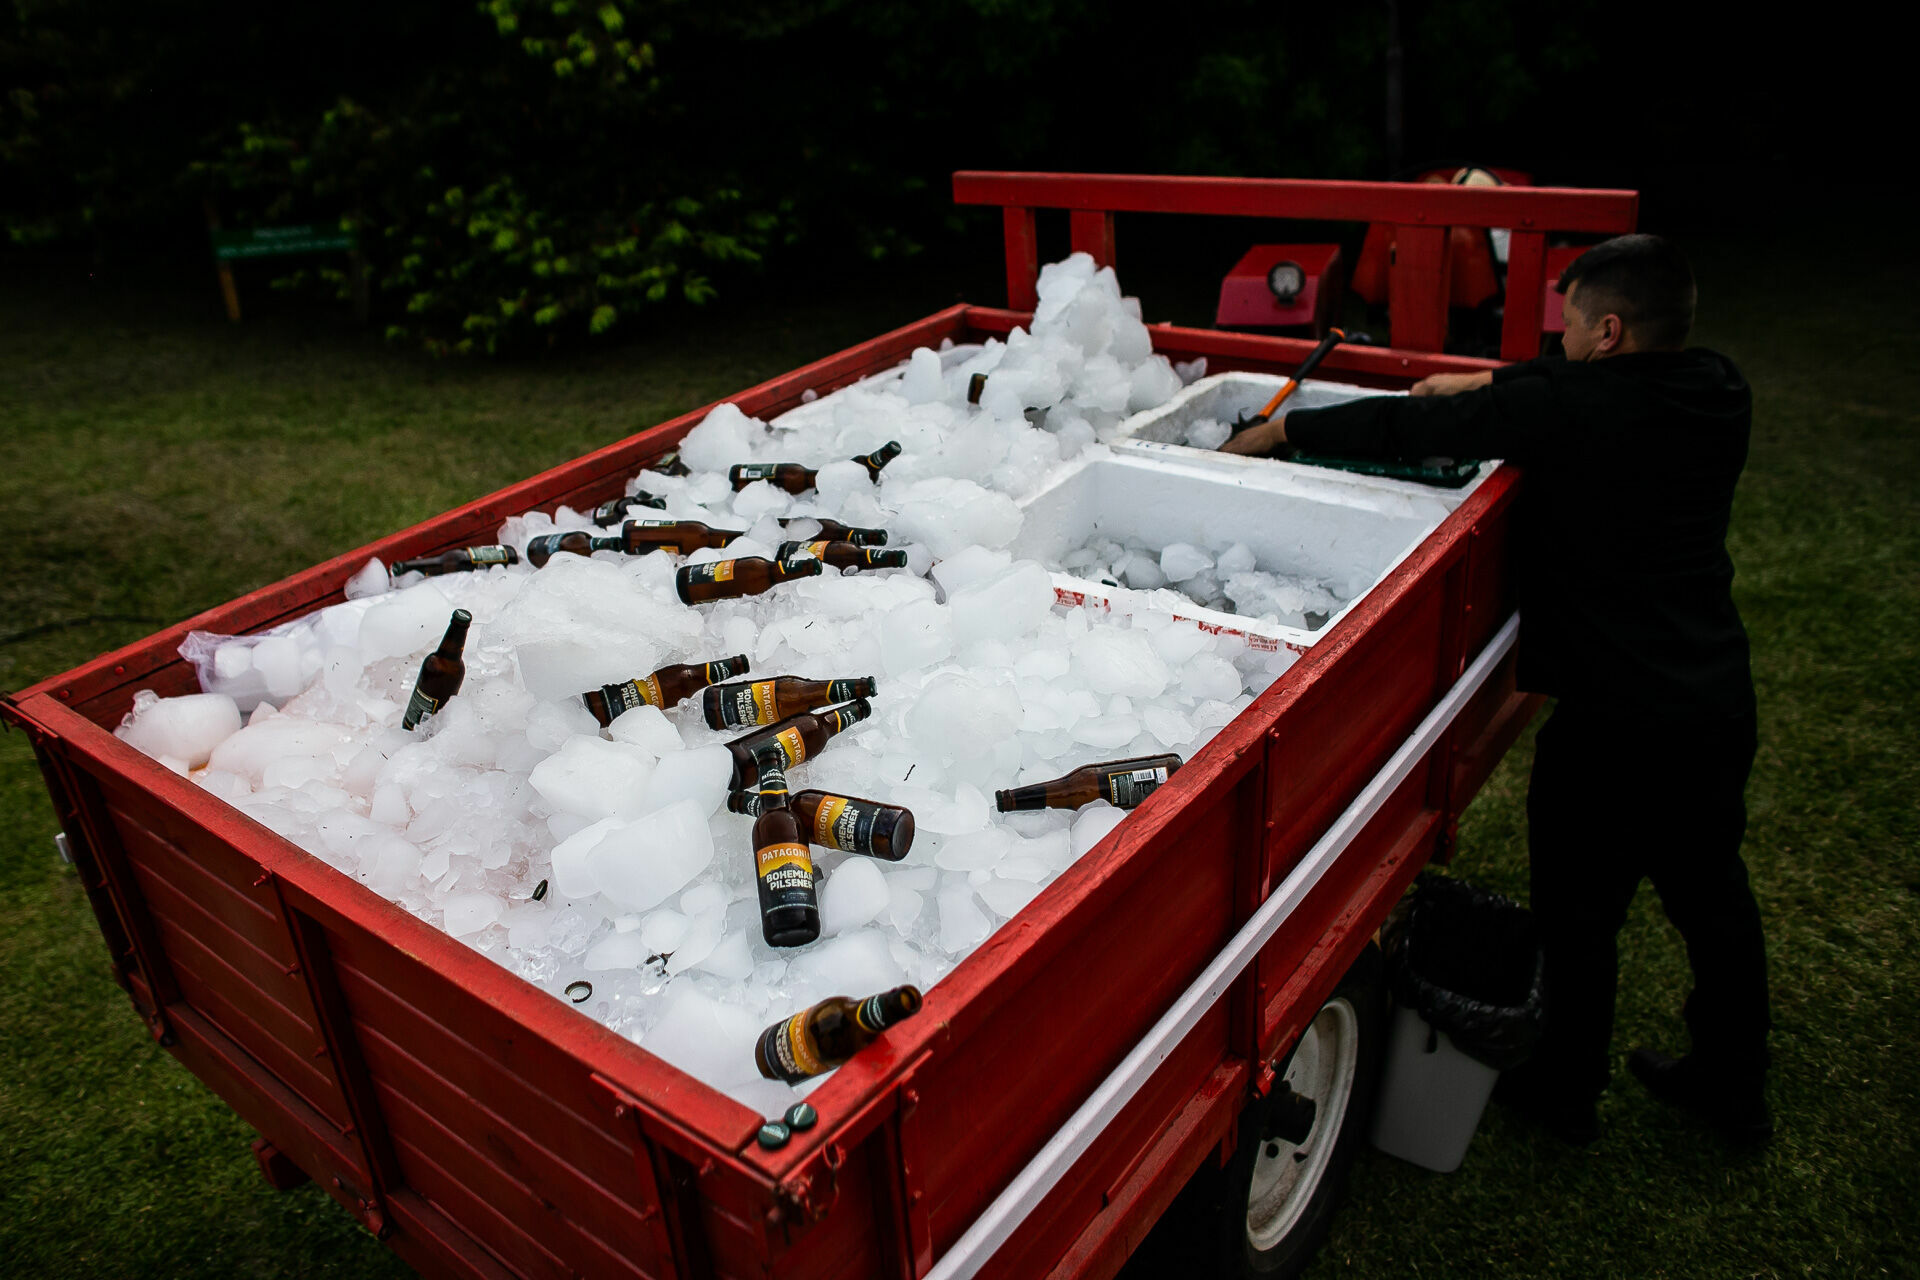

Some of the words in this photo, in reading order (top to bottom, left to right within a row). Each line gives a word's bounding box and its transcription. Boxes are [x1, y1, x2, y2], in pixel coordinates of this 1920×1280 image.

[620, 688, 632, 709] PILSE
[627, 683, 641, 706] BOHE
[762, 685, 776, 724] PATAGONI
[788, 733, 803, 767] PATAGO
[767, 869, 813, 884] BOHEMIAN
[770, 879, 813, 892] PILSENER
